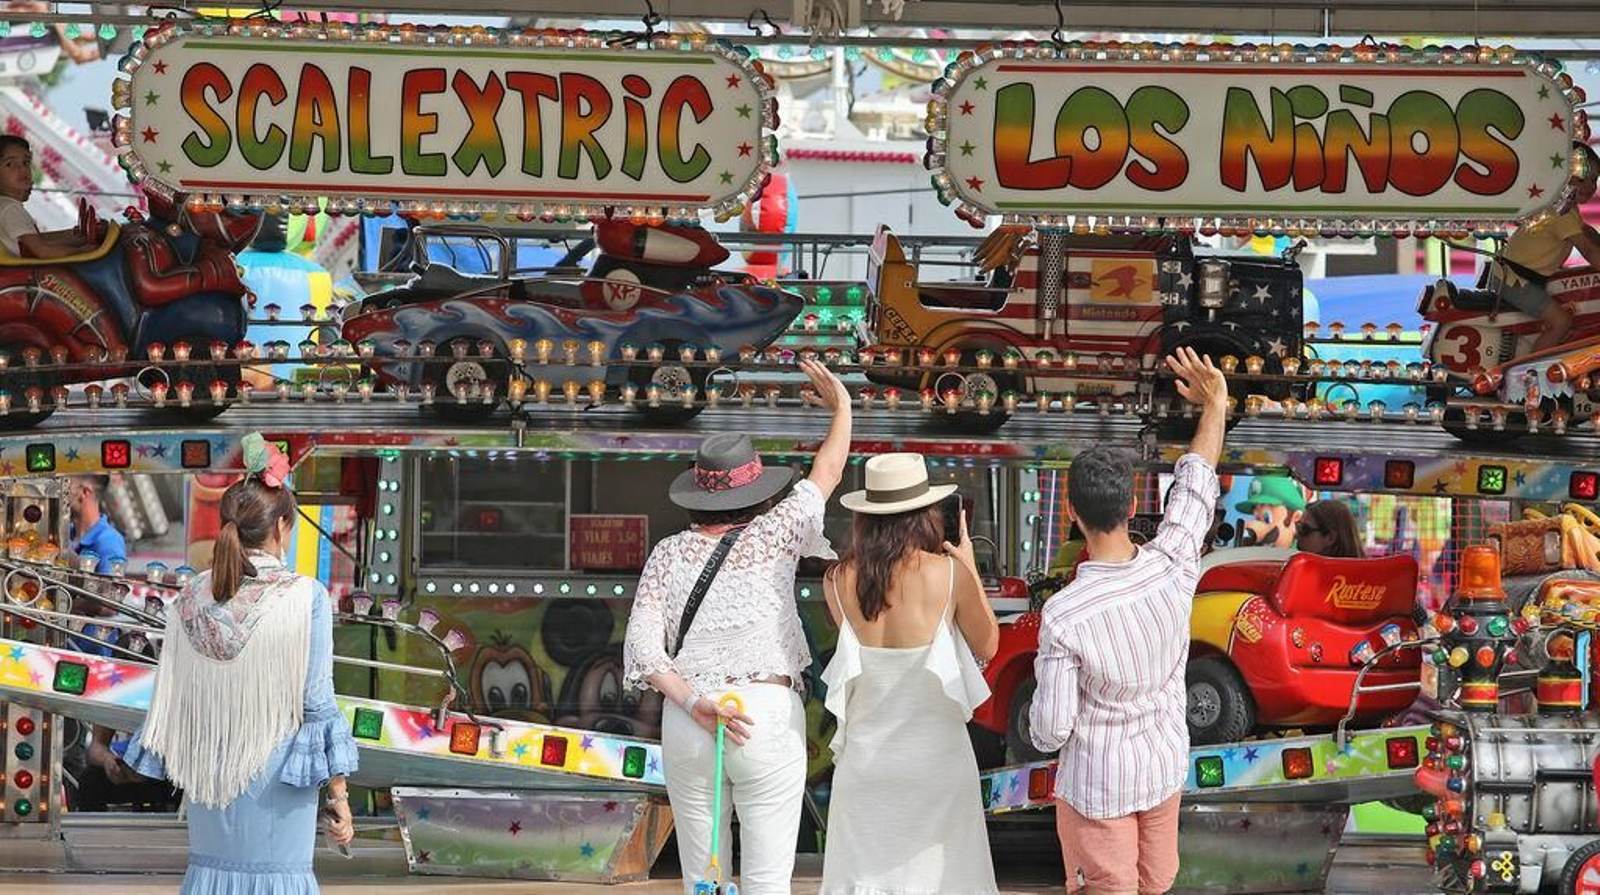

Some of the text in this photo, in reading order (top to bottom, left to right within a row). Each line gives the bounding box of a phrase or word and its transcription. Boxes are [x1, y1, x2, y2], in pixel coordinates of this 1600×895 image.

[993, 82, 1191, 192] LOS
[885, 308, 919, 343] CEPSA
[1441, 326, 1482, 373] 3
[1485, 346, 1493, 357] 6
[1576, 402, 1592, 413] 16
